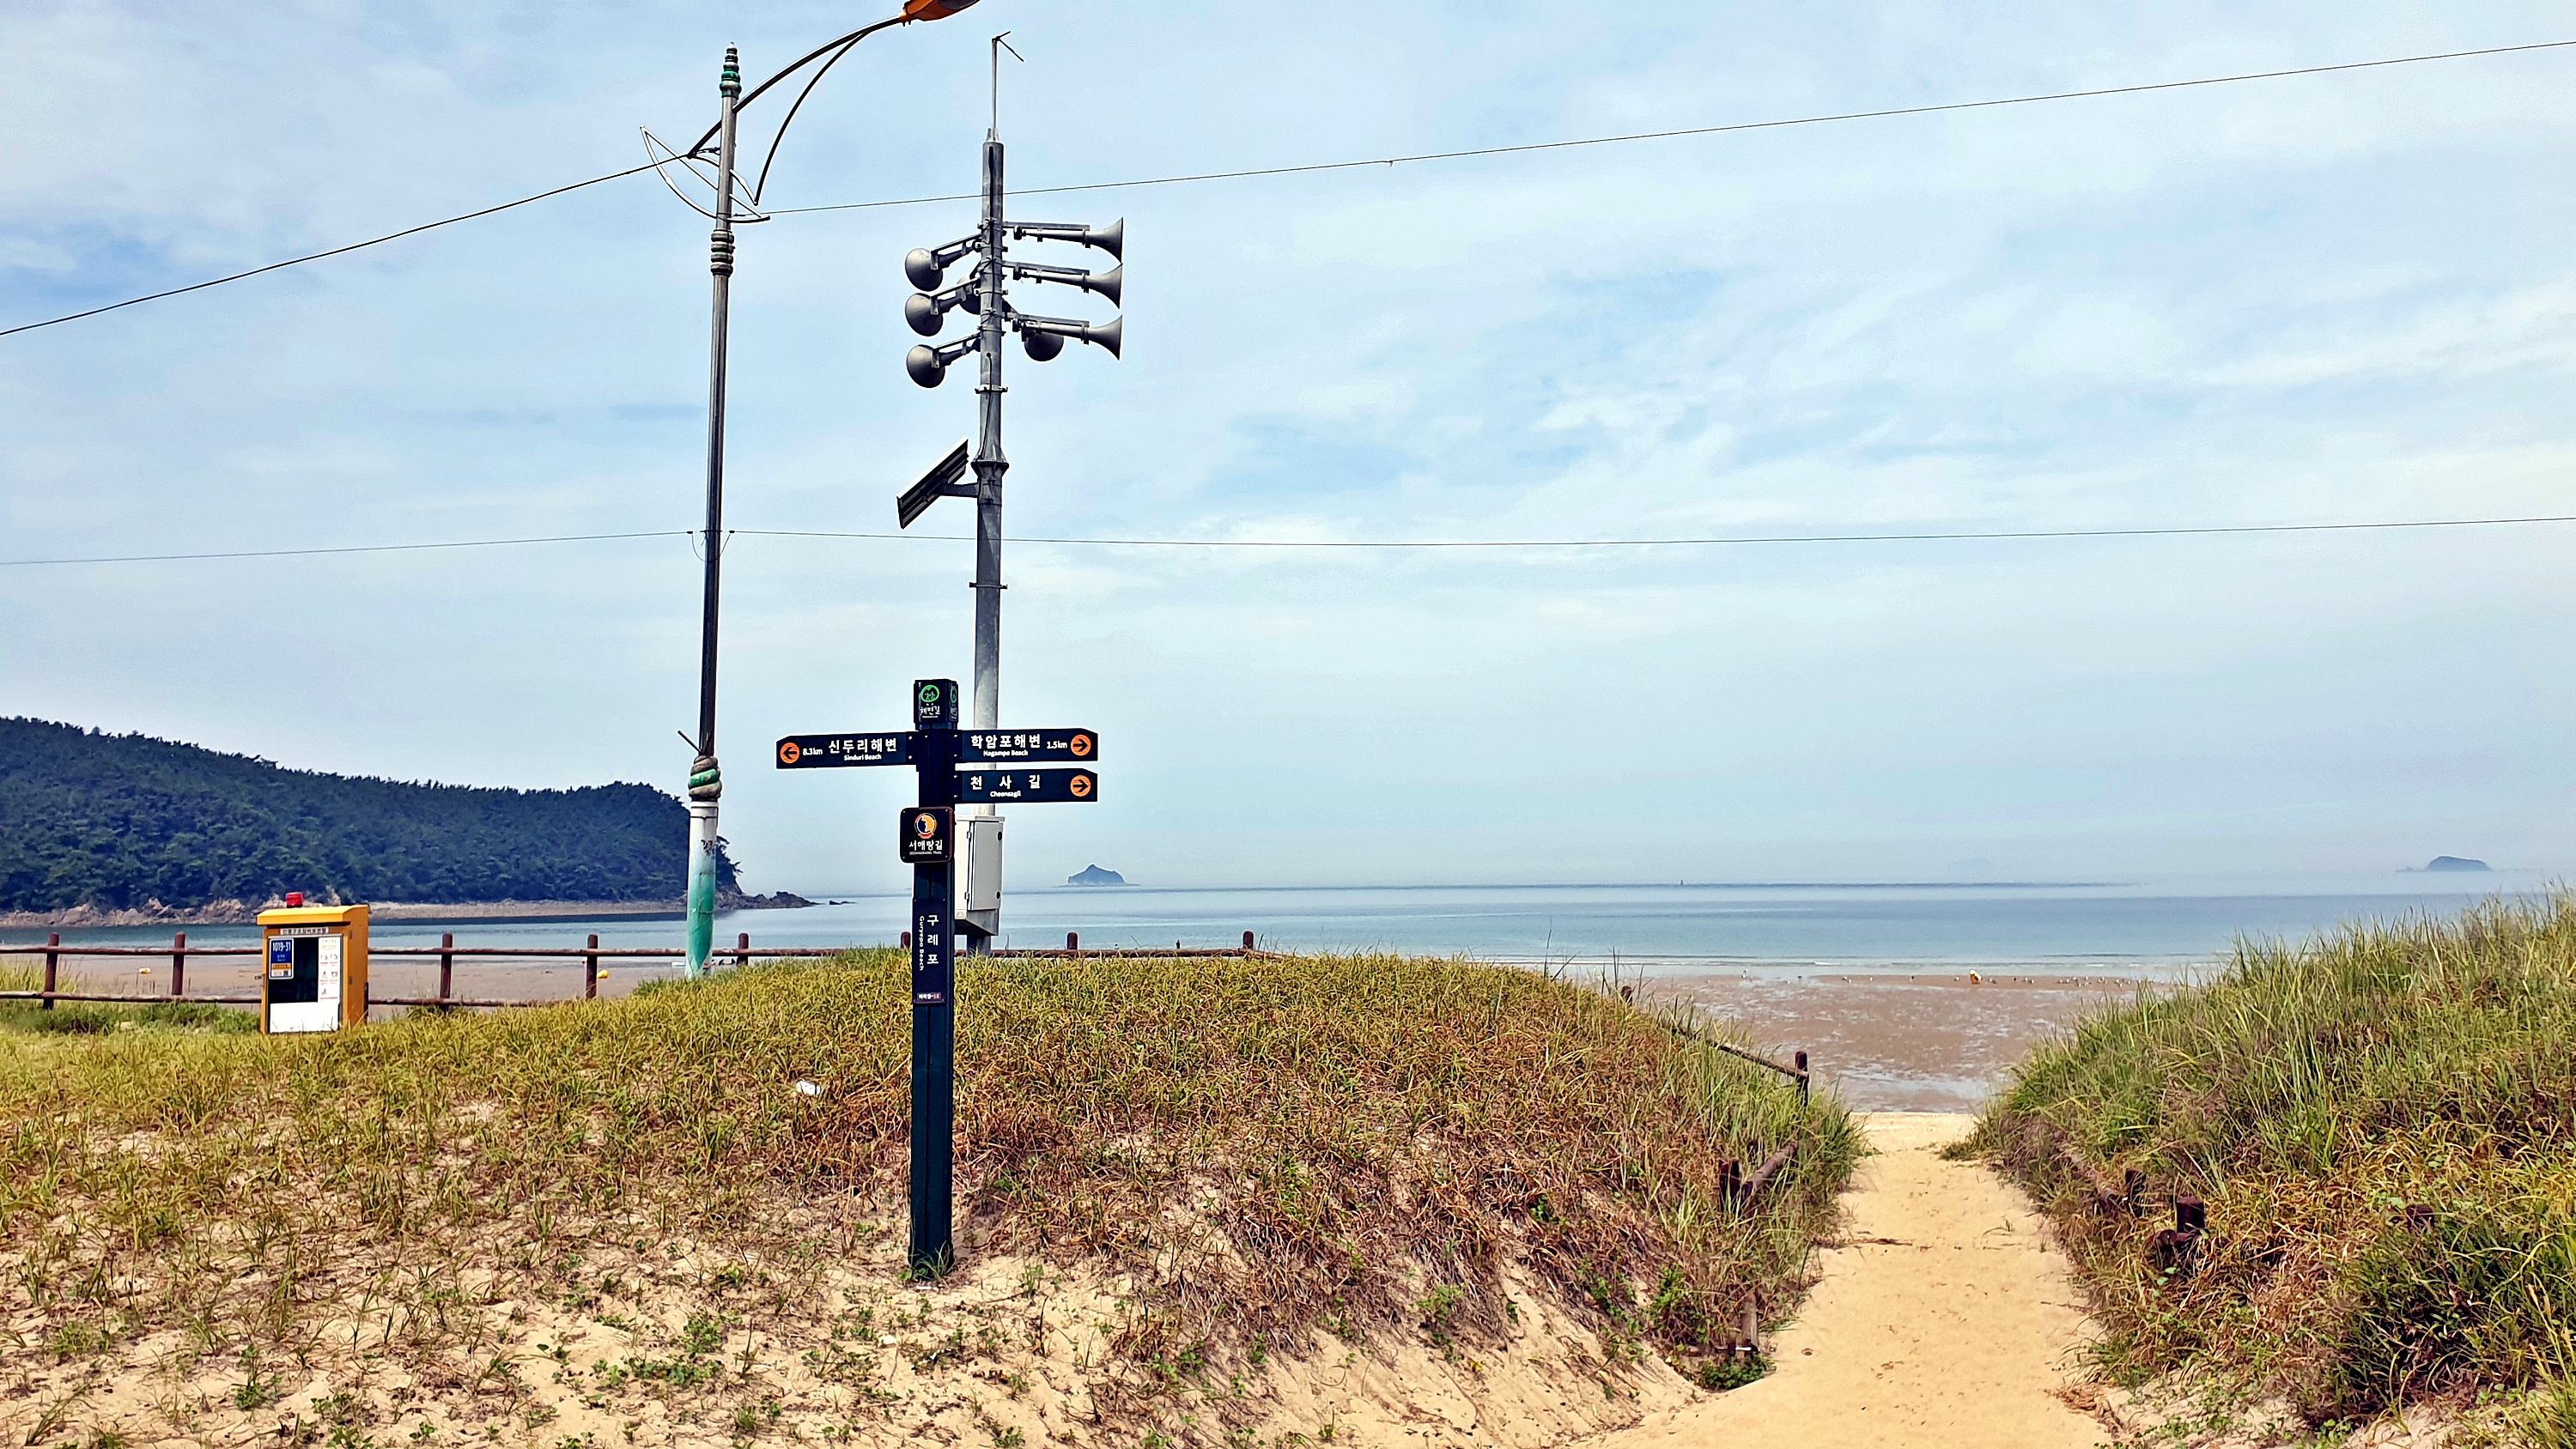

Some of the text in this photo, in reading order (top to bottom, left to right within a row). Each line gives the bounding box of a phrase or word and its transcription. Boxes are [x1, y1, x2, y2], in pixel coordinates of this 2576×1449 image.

[828, 737, 897, 754] 신두리해변
[970, 734, 1067, 749] 학암포해변 1.5km
[927, 914, 939, 964] 구례포
